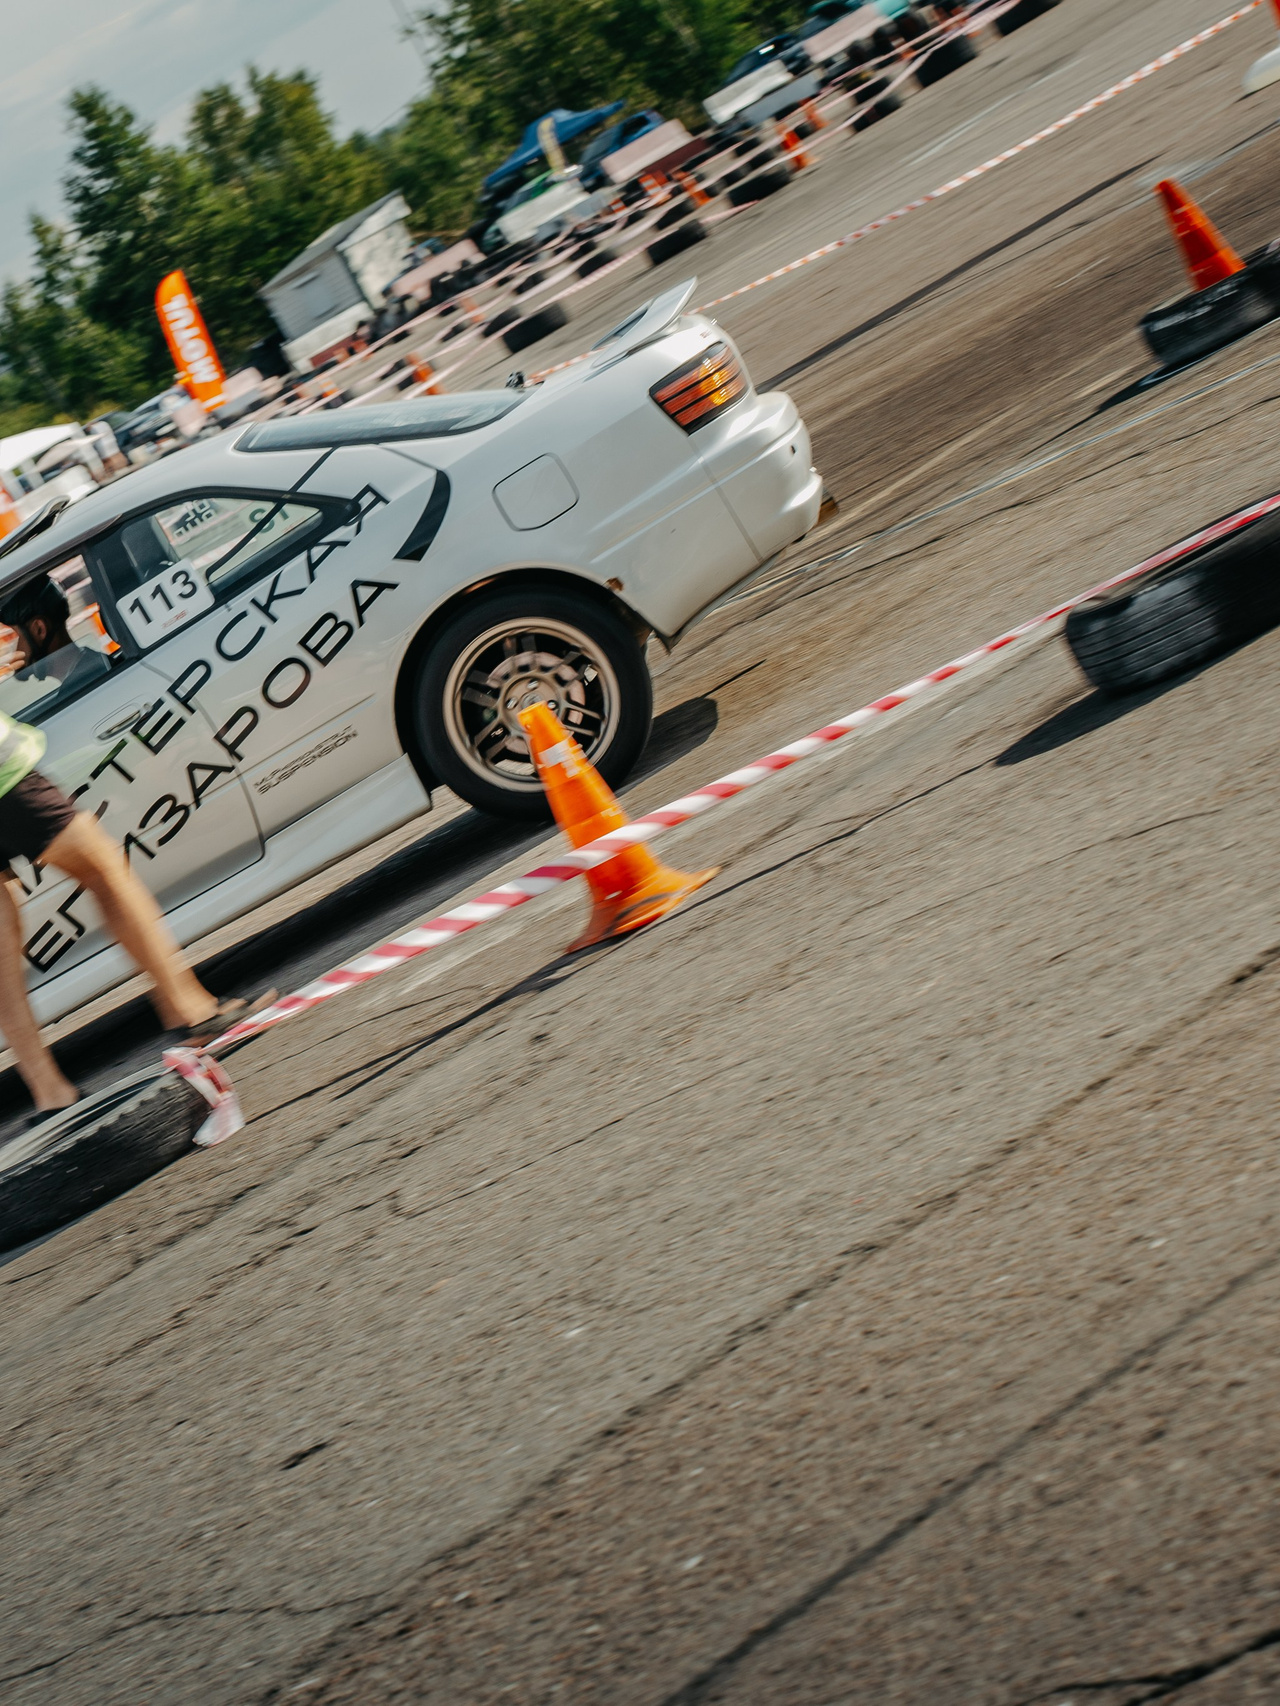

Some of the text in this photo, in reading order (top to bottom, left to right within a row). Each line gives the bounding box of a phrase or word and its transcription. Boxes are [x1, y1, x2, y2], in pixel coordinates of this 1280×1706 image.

[162, 293, 221, 384] MOTUL
[128, 570, 198, 625] 113
[17, 483, 390, 897] ТЕРСКАЯ
[257, 731, 358, 795] SUSPENSION
